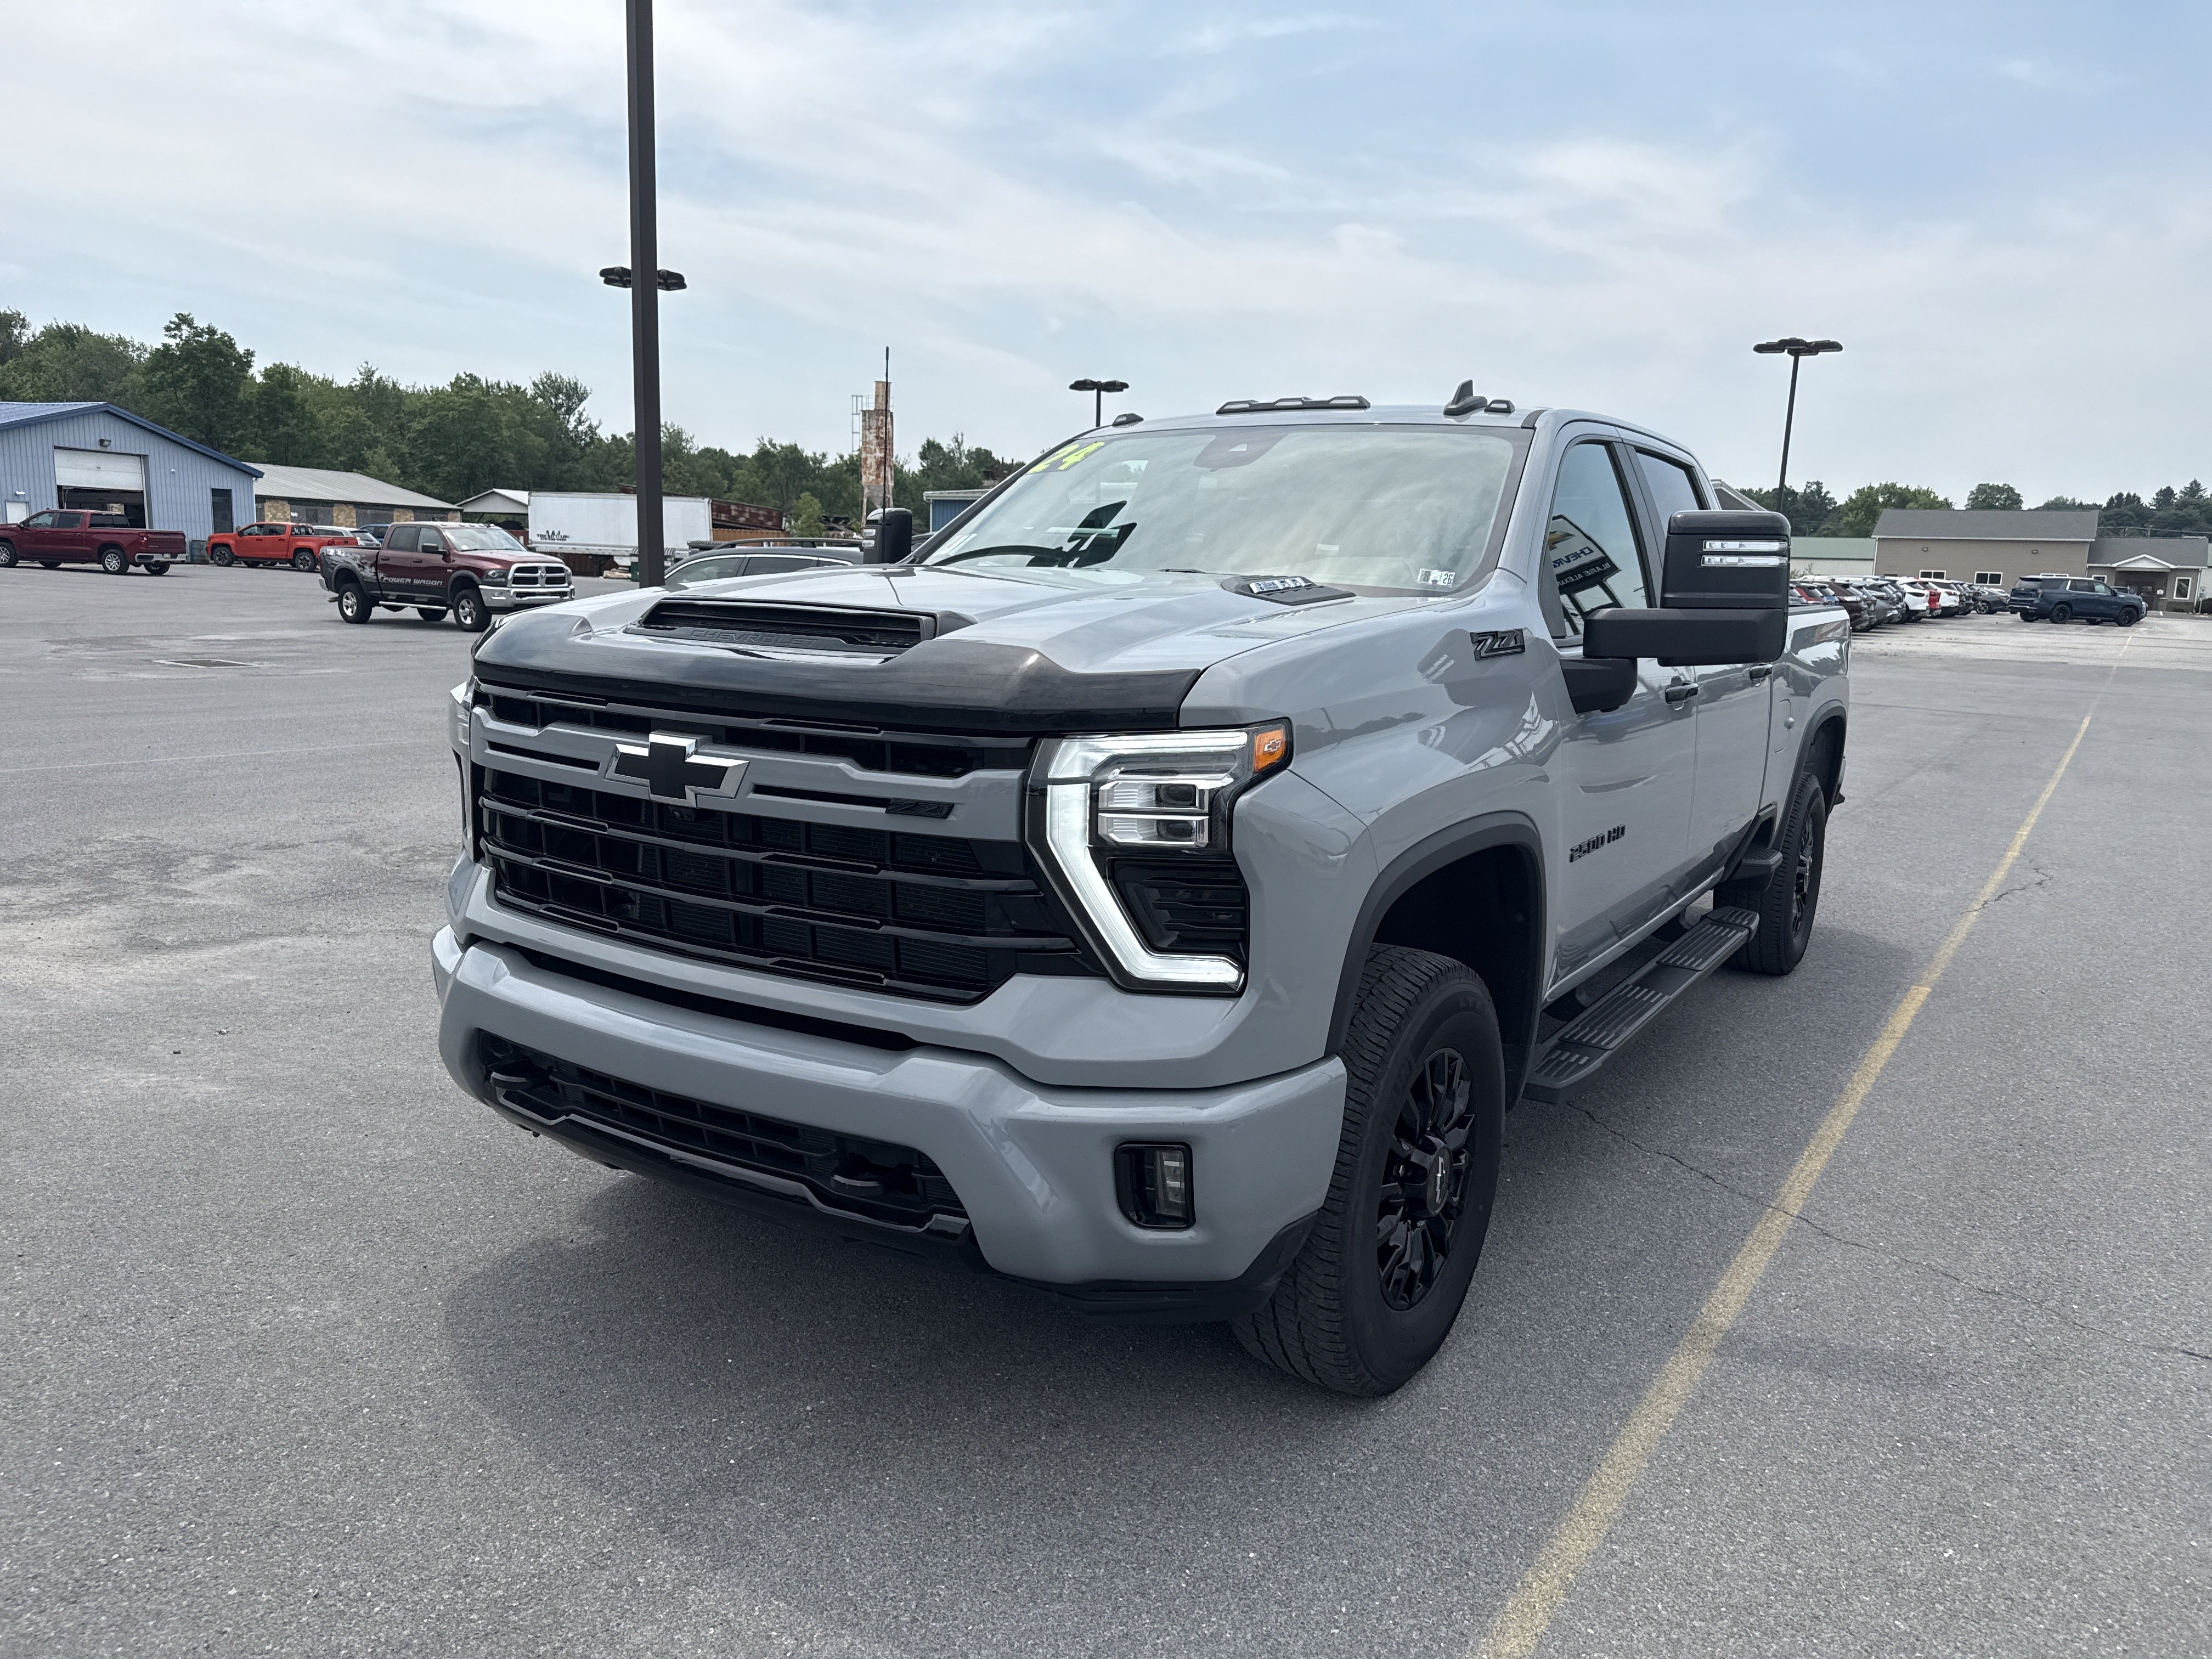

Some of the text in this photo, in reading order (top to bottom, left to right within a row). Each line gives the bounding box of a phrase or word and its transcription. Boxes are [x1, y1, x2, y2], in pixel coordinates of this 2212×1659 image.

[1028, 443, 1105, 475] 24
[413, 578, 443, 586] WAGON
[1442, 573, 1454, 585] 26
[1470, 628, 1526, 661] Z71
[885, 798, 955, 819] Z71
[1569, 823, 1626, 863] 2500 HD
